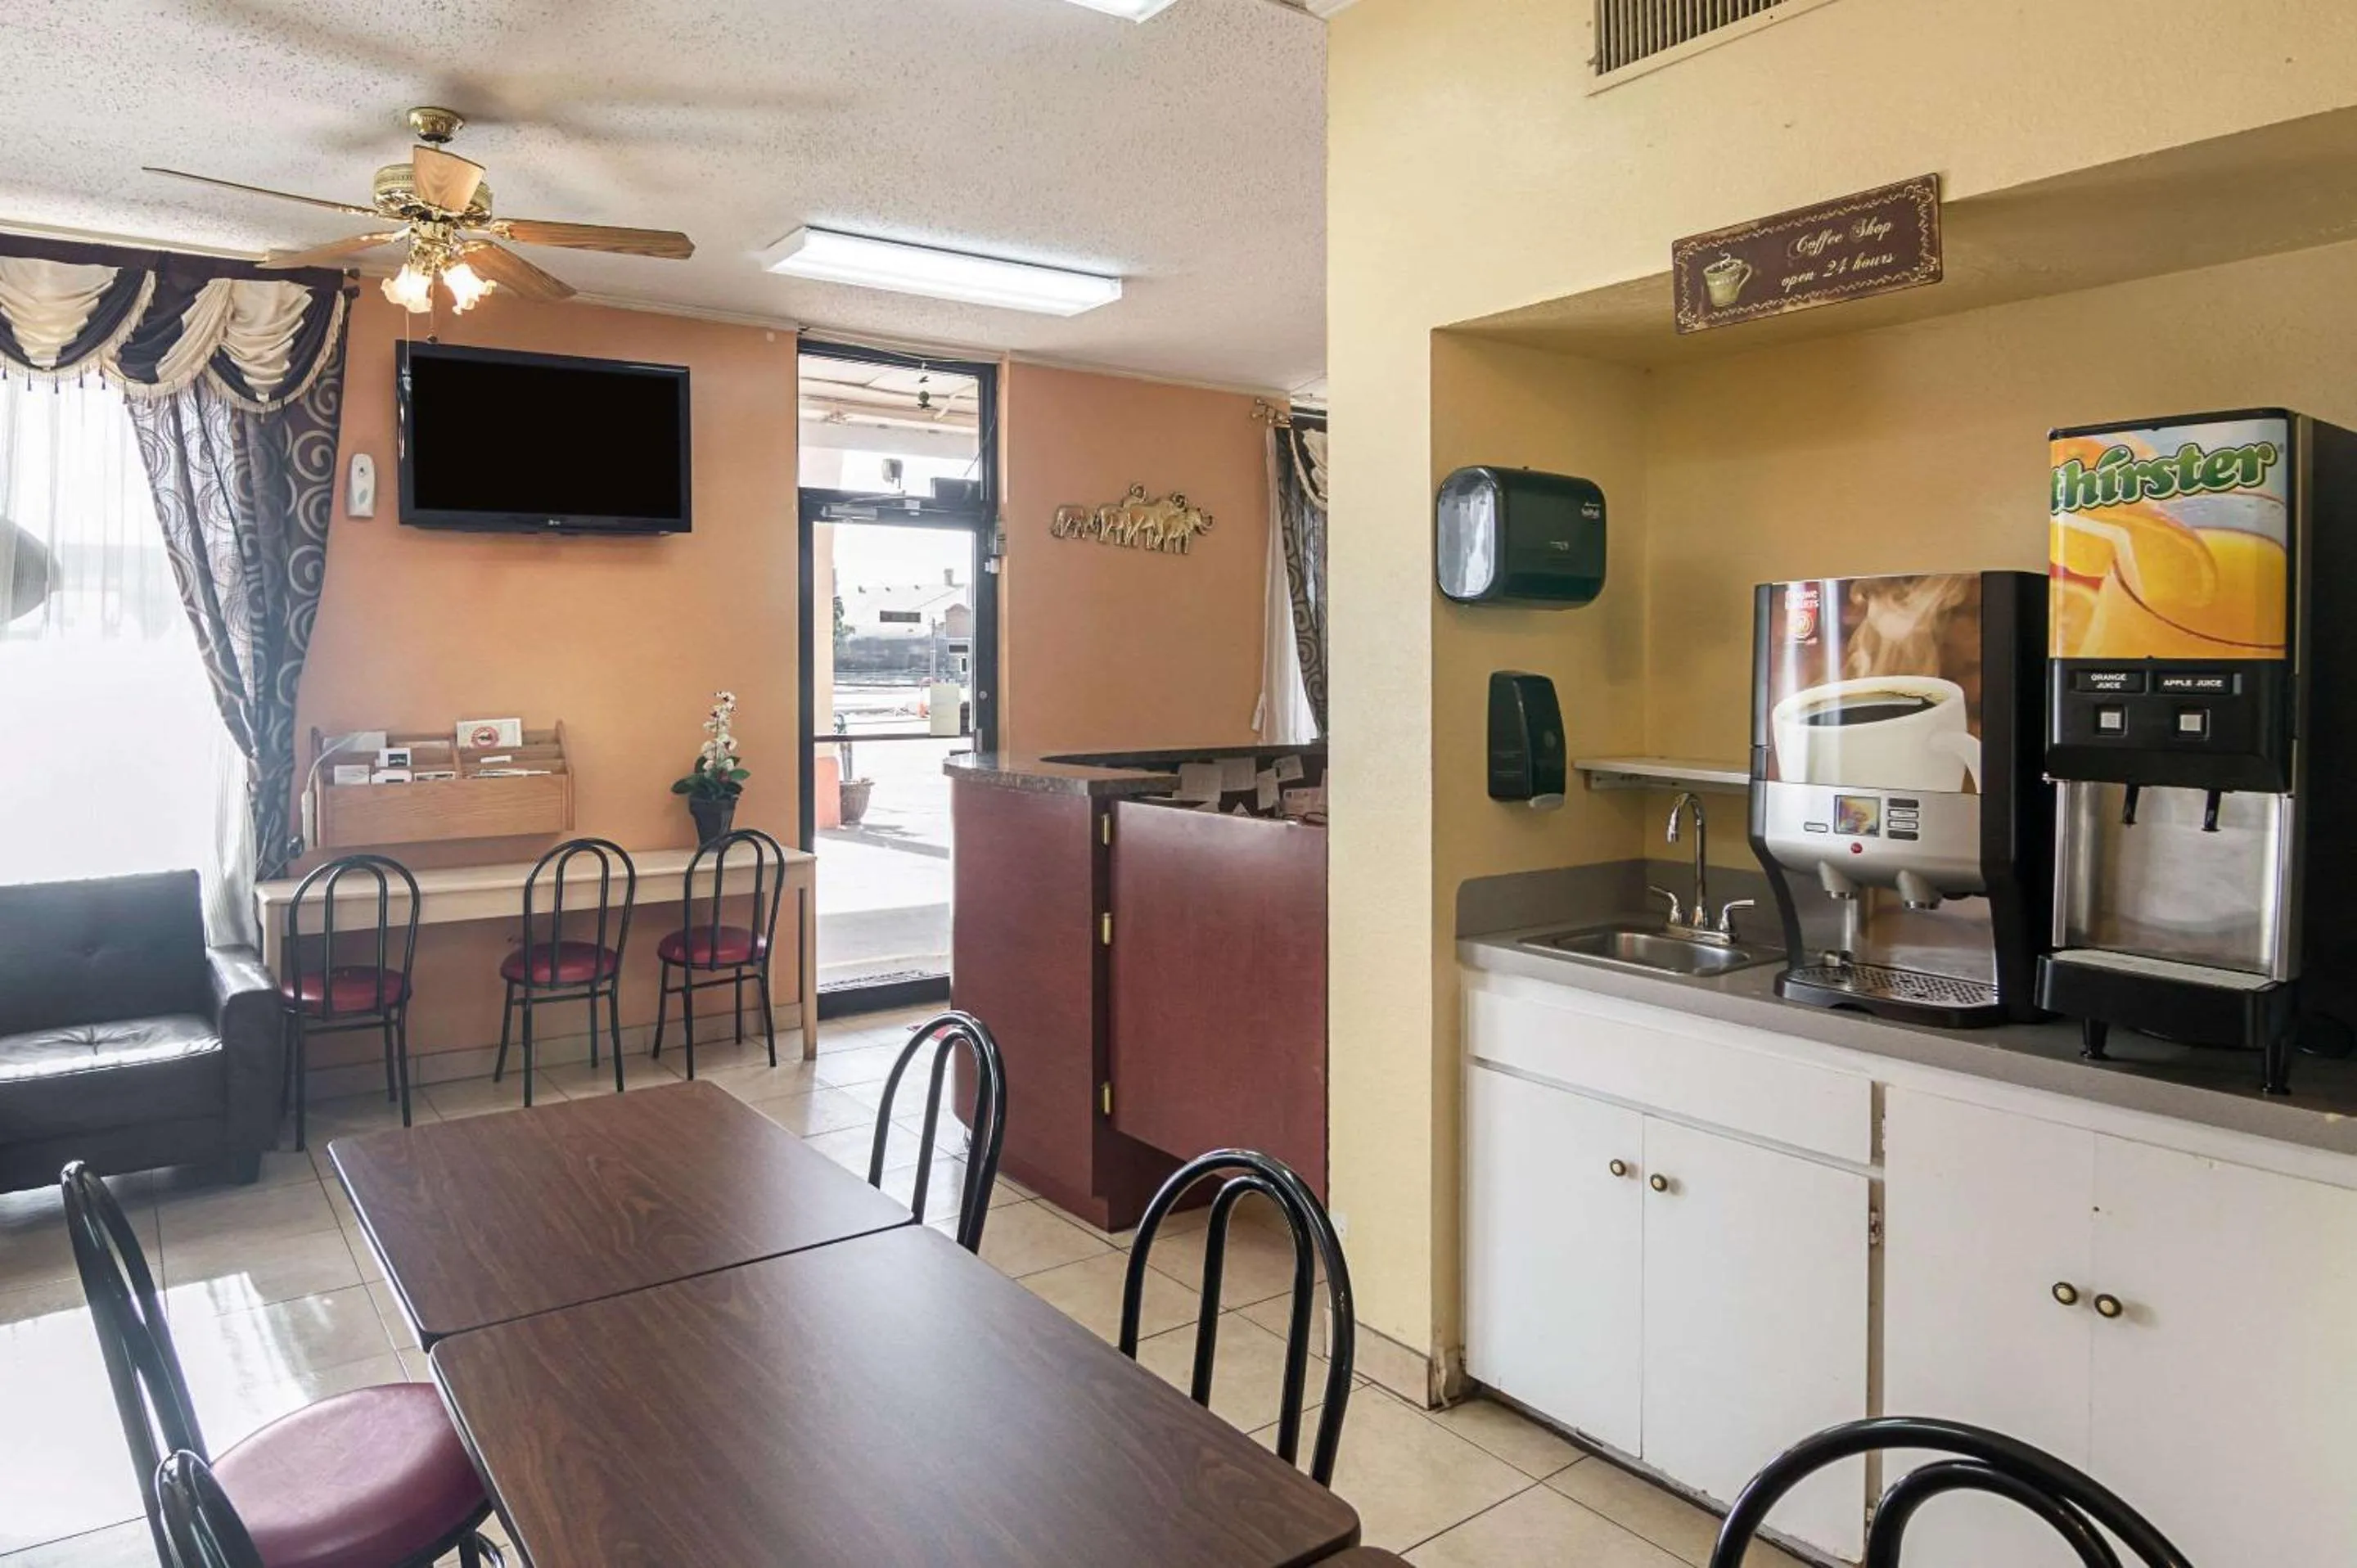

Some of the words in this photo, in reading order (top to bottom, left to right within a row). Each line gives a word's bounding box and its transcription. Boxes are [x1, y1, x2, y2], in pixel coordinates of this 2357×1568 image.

[1787, 228, 1843, 258] Coffee
[1850, 216, 1892, 243] Shop
[1781, 271, 1815, 293] open
[1822, 257, 1848, 277] 24
[1852, 252, 1895, 271] hours
[2090, 673, 2127, 682] ORANGE
[2096, 681, 2121, 690] JUICE
[2163, 679, 2193, 687] APPLE
[2196, 679, 2223, 688] JUICE
